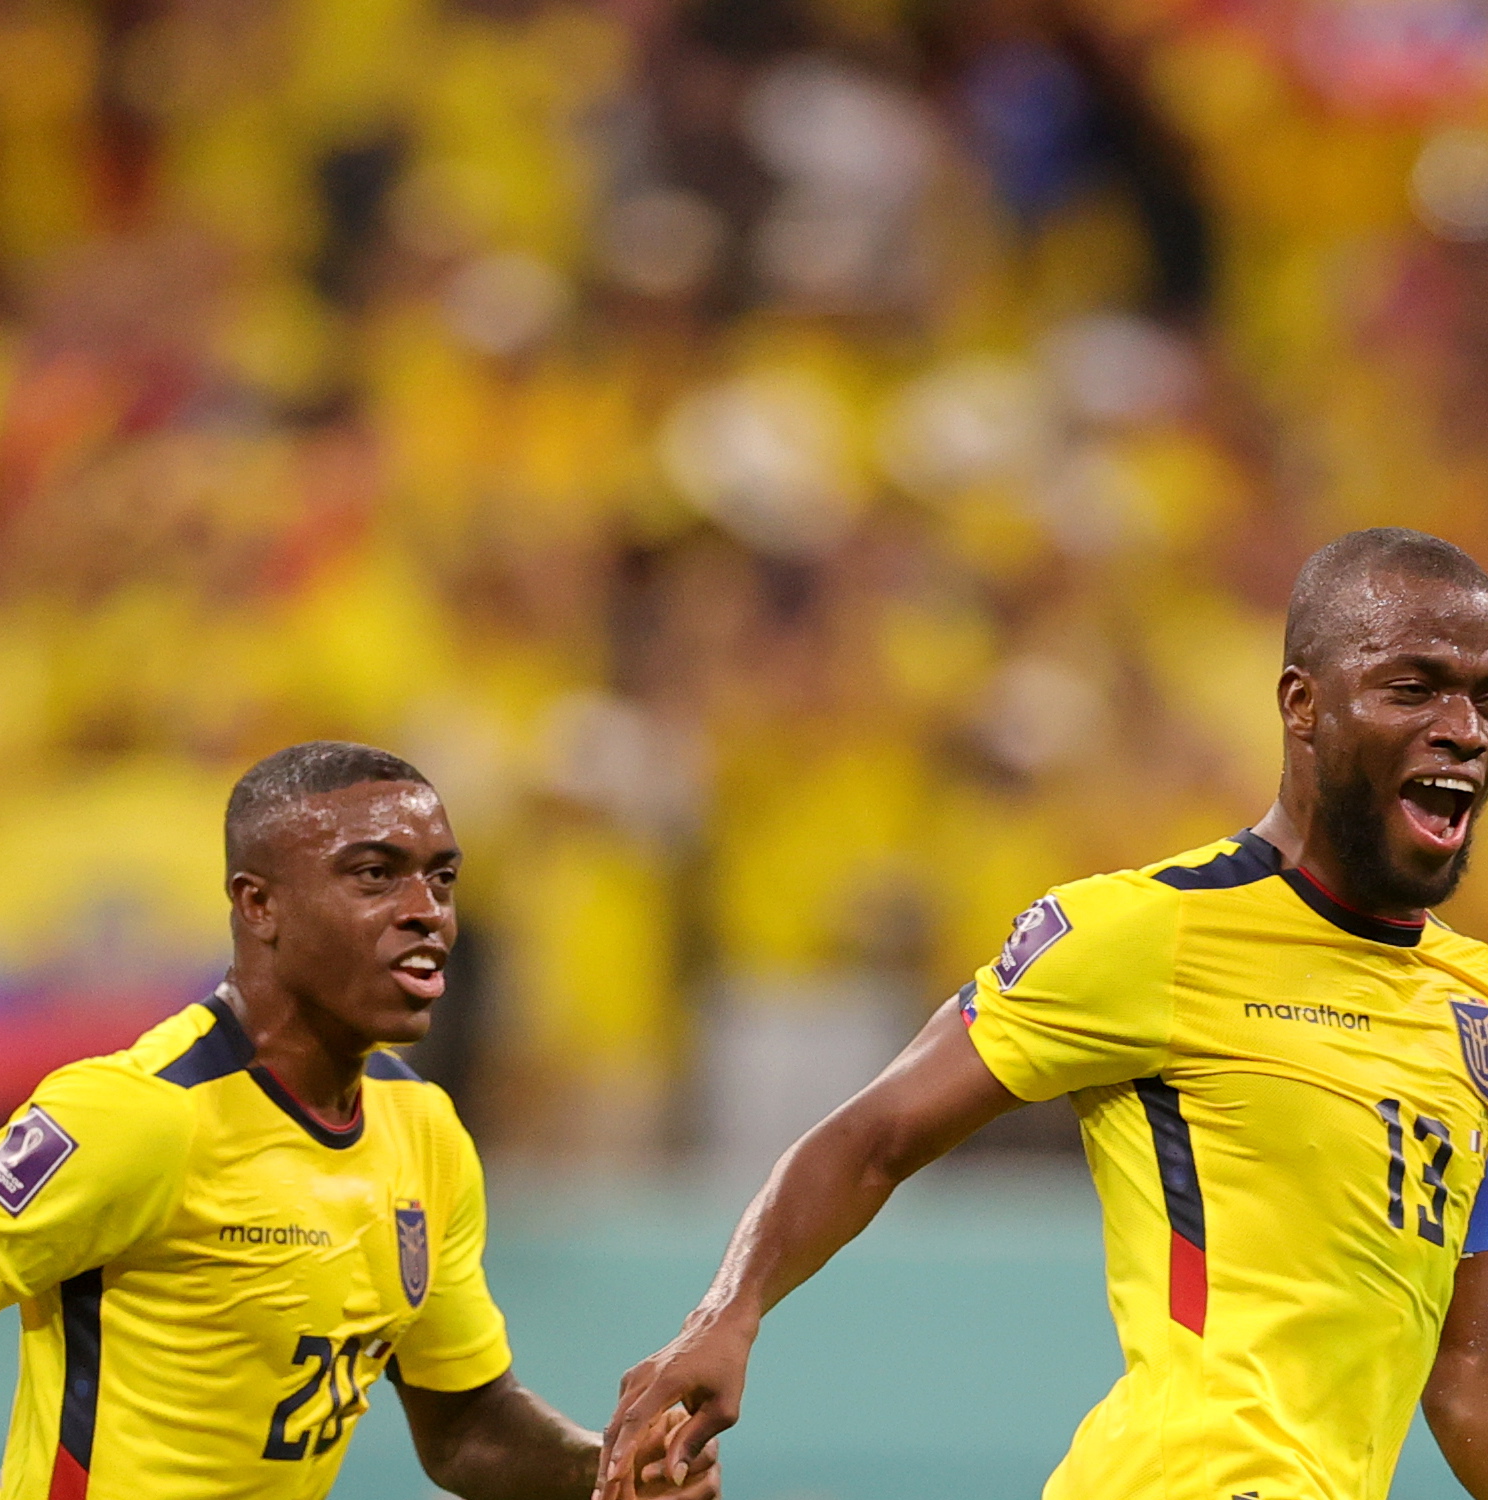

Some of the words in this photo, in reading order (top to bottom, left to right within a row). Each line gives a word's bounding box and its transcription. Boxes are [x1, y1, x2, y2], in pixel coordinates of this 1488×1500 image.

[1244, 1002, 1371, 1032] marathon
[1375, 1098, 1453, 1248] 13
[219, 1223, 333, 1247] marathon
